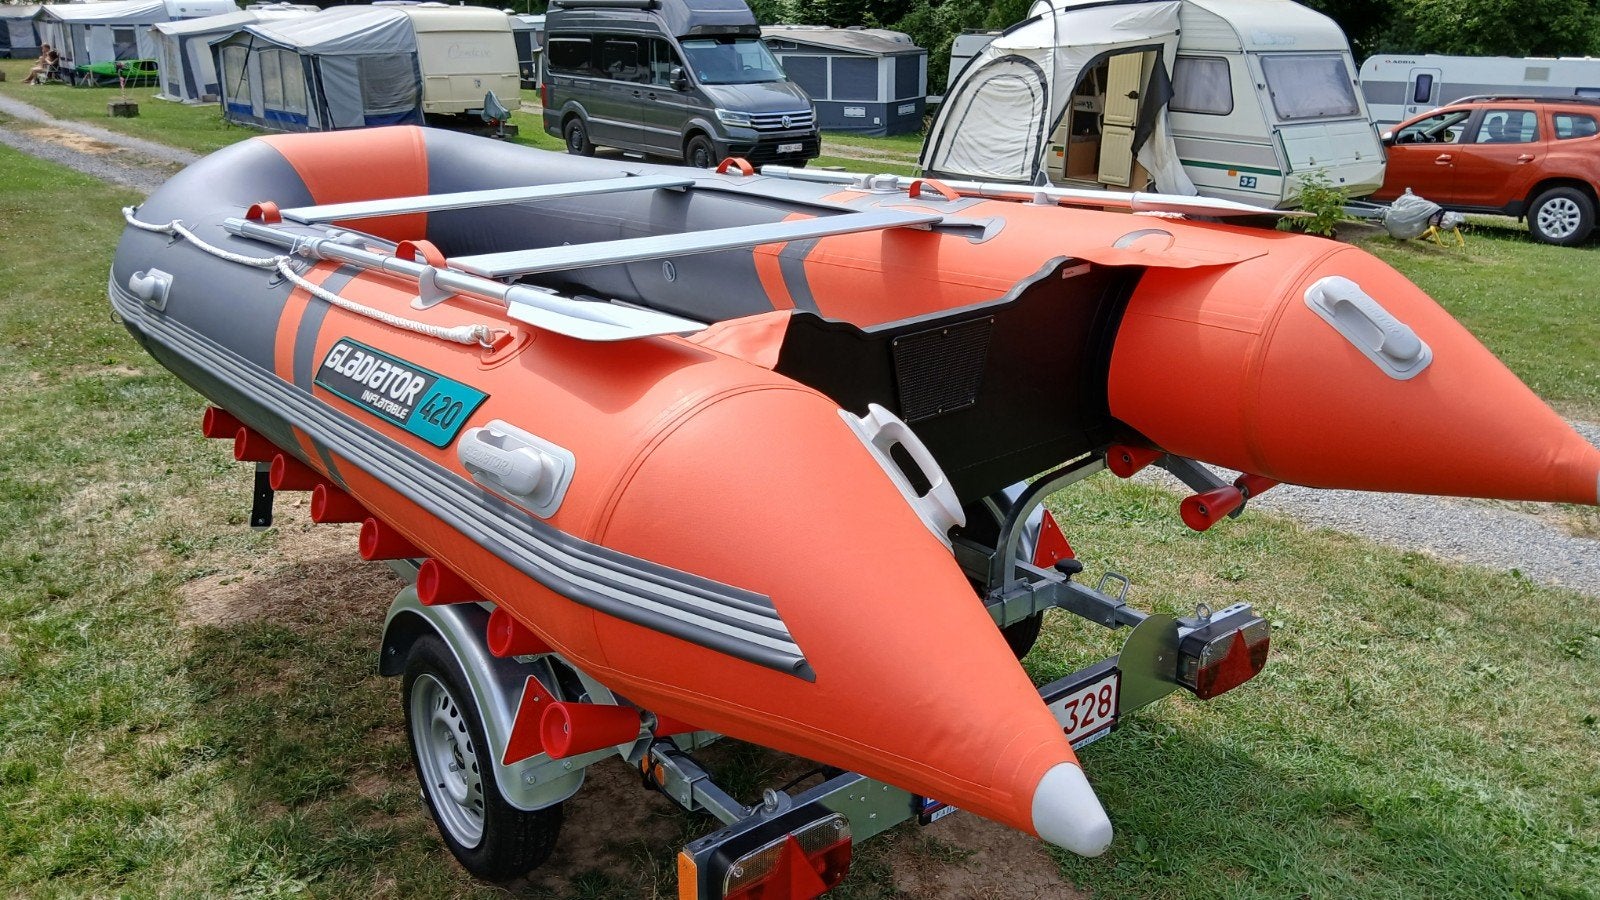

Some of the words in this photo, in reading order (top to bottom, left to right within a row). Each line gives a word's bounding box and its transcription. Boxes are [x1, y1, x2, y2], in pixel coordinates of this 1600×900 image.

[1240, 177, 1256, 187] 32
[419, 392, 464, 430] 420
[1063, 684, 1113, 735] 328
